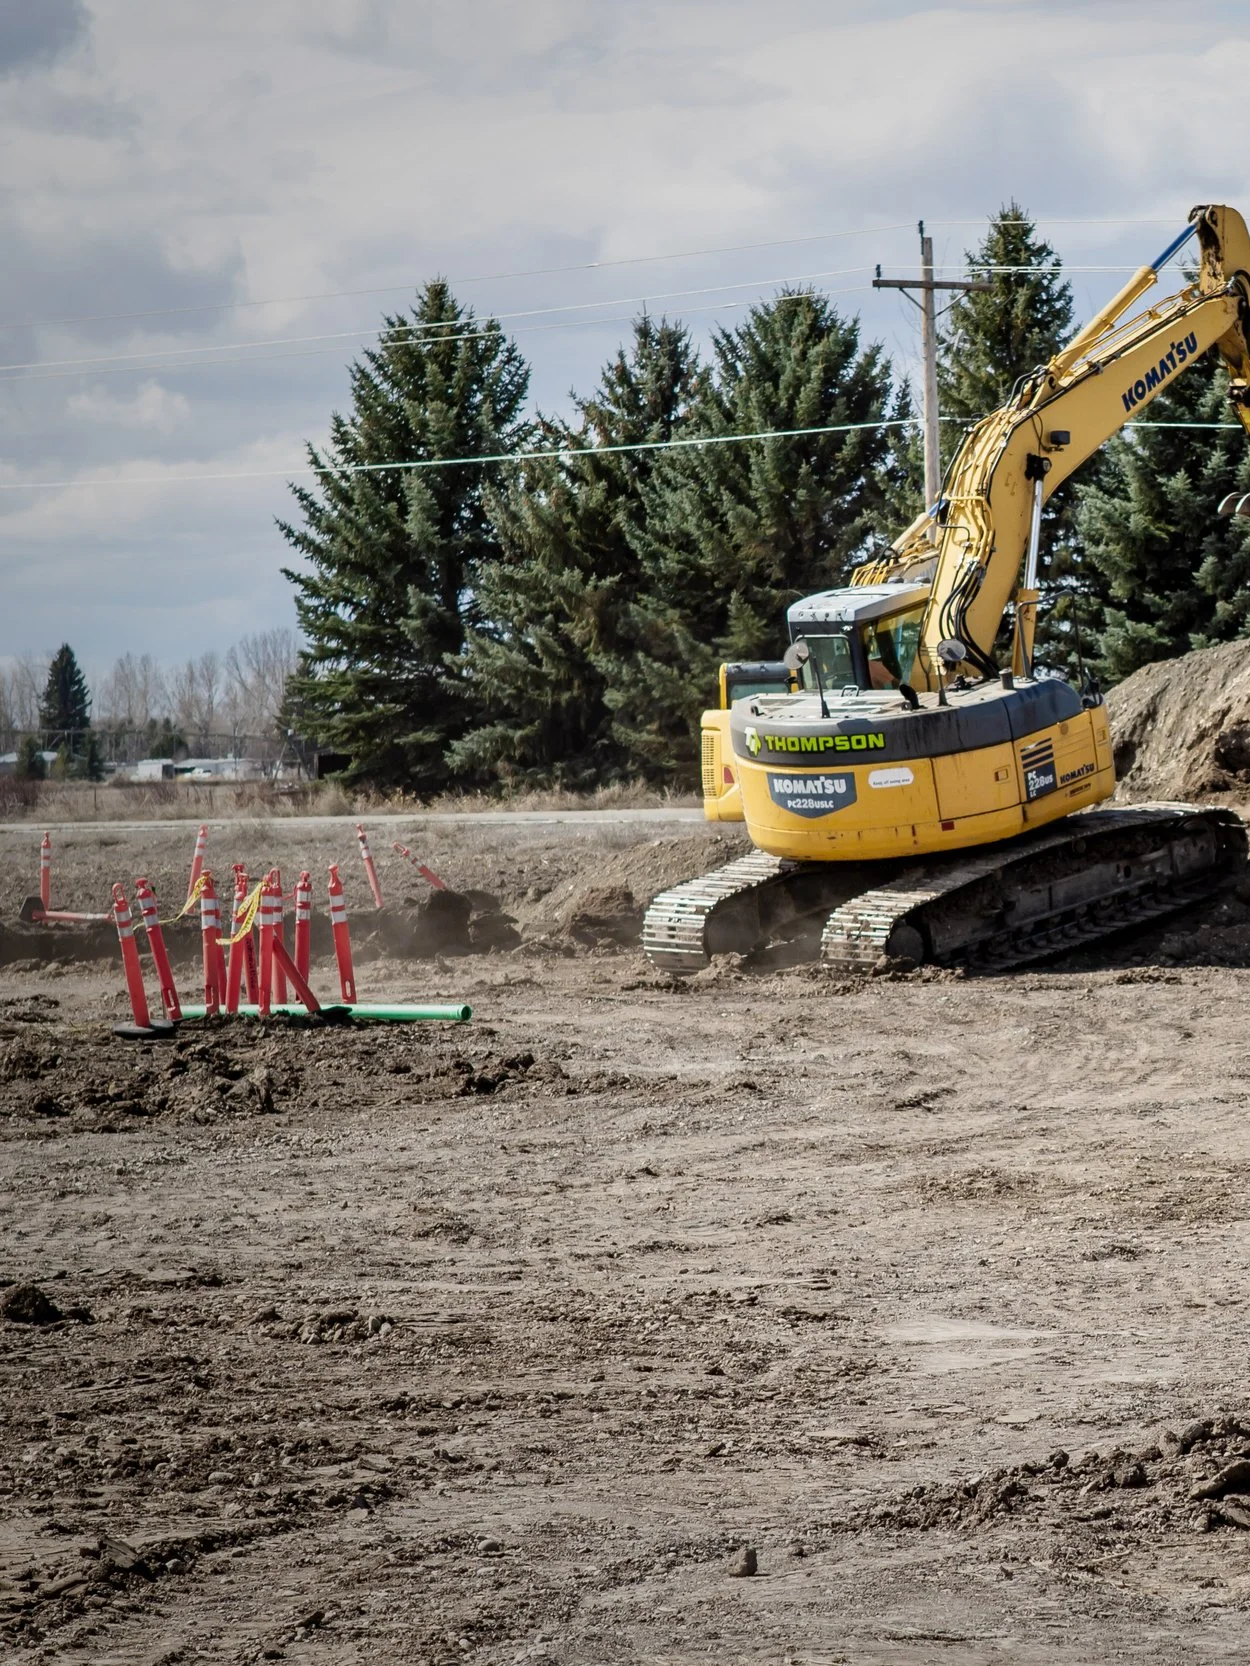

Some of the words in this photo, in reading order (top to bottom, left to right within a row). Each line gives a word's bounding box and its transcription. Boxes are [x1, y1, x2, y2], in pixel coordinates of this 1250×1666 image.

[1121, 331, 1198, 413] KOMATSU
[765, 733, 885, 751] THOMPSON
[1060, 763, 1095, 784] KOMATSU
[773, 776, 847, 795] KOMATSU
[787, 799, 834, 809] PC228USLC
